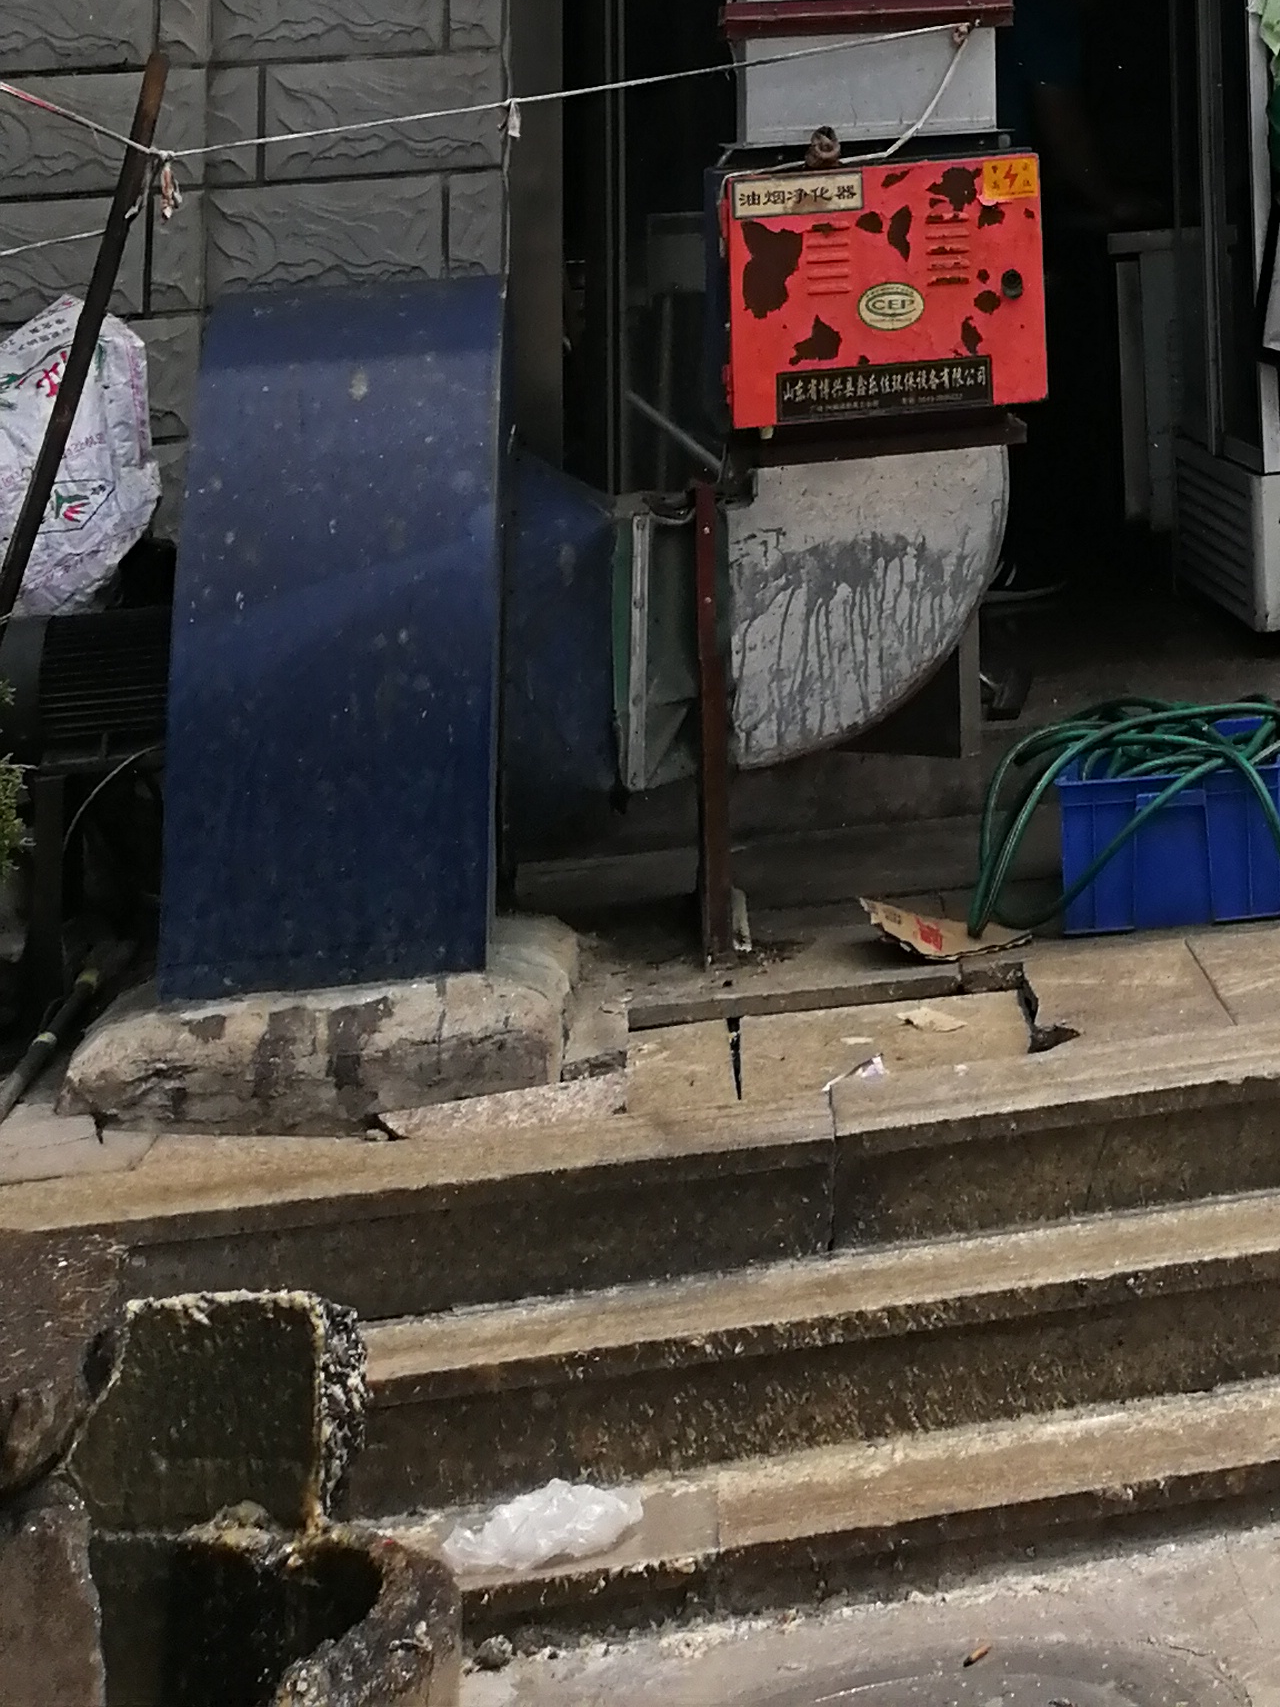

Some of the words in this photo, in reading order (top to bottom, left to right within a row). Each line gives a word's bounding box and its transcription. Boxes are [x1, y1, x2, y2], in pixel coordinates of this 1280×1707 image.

[738, 185, 857, 207] 油烟净化器
